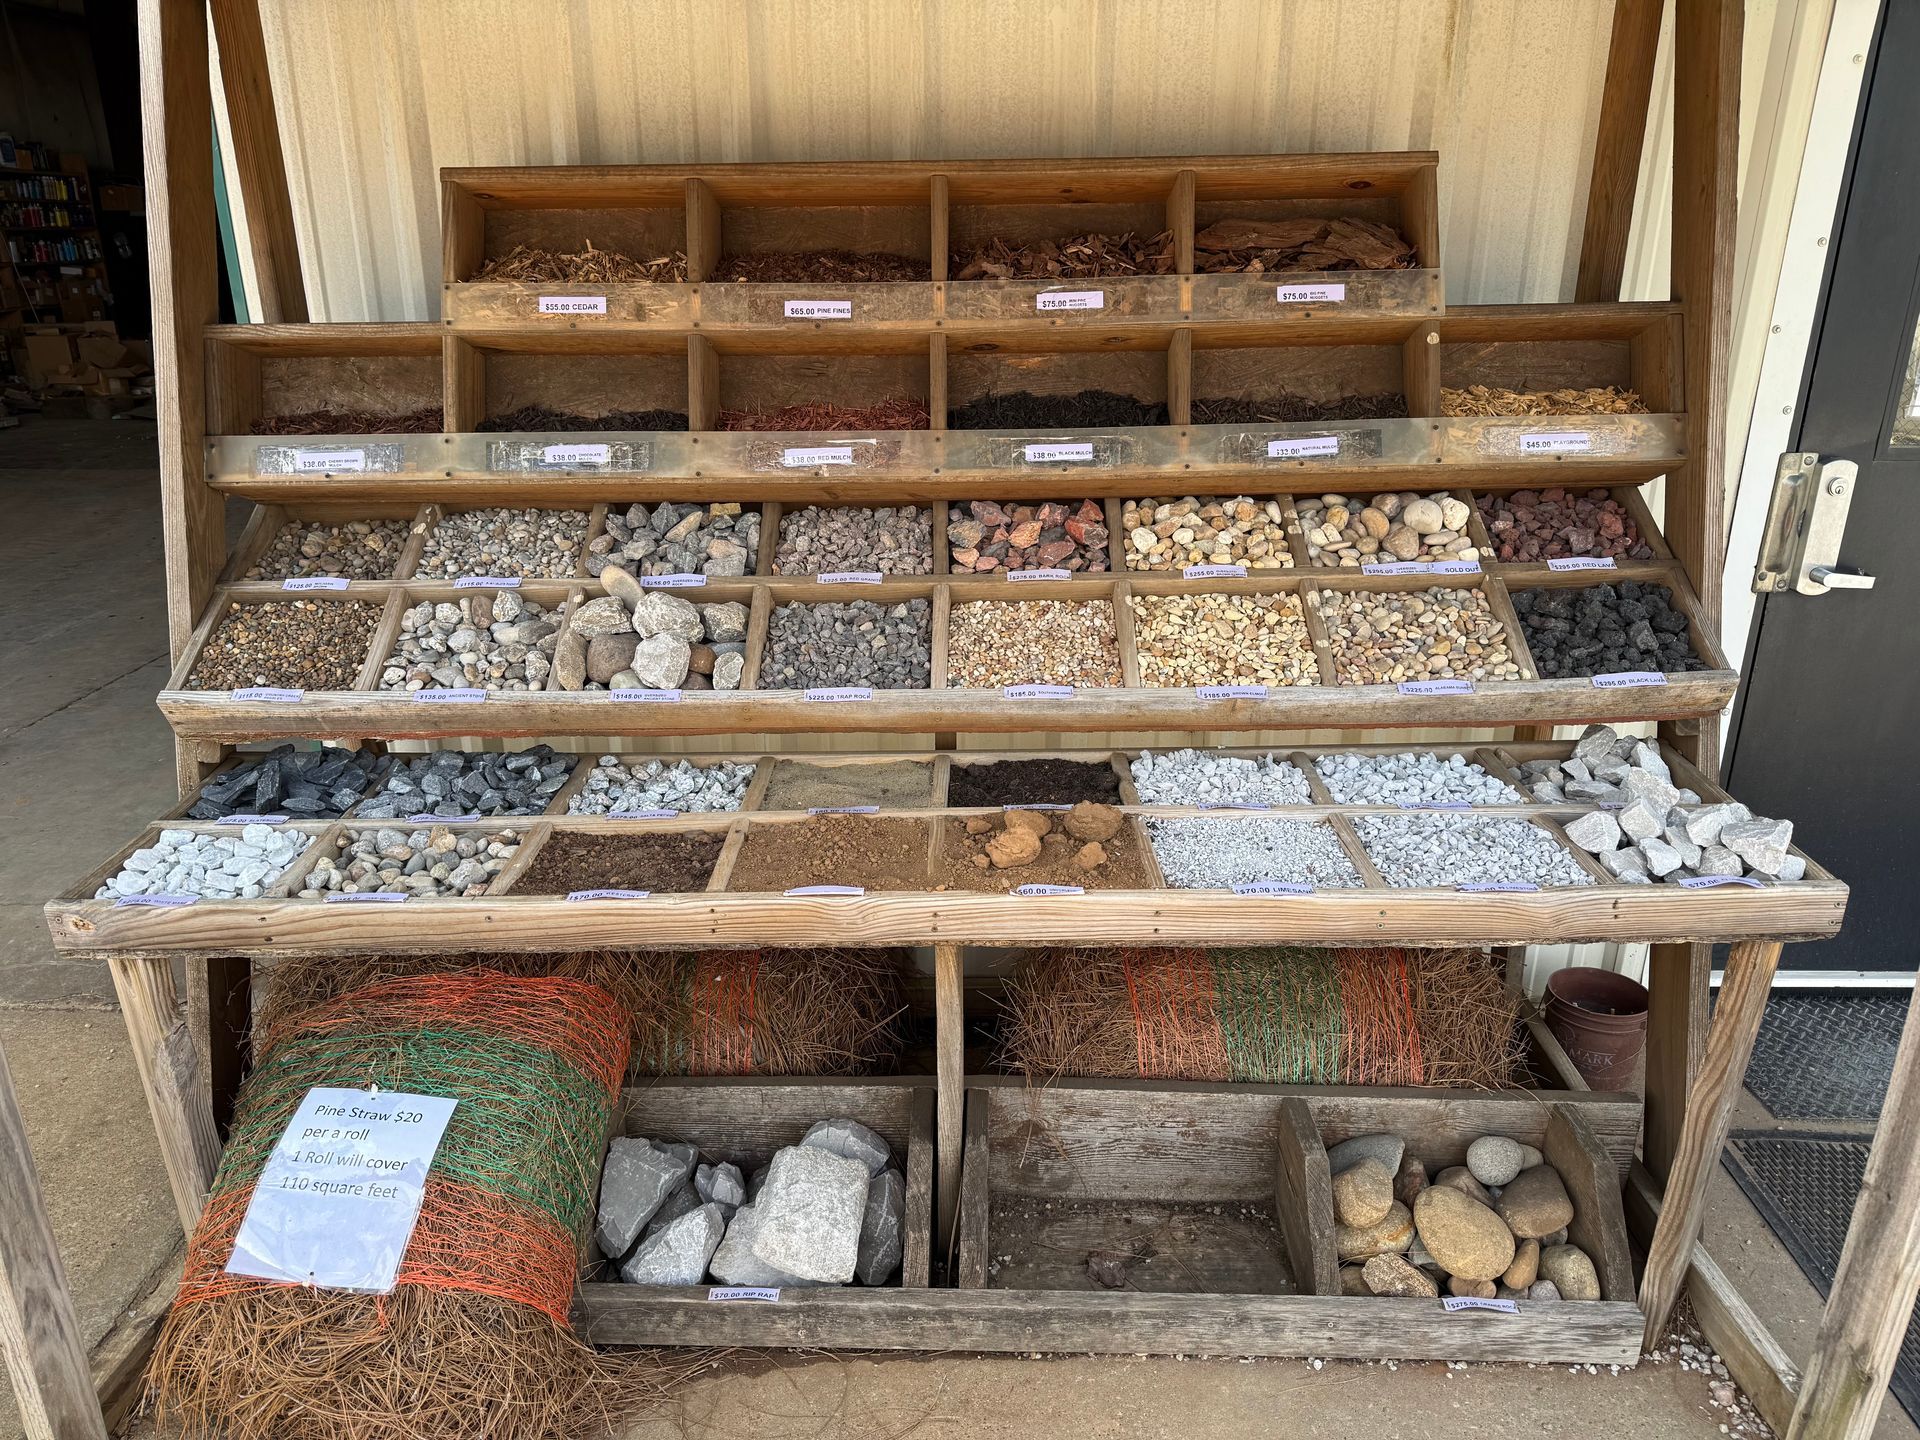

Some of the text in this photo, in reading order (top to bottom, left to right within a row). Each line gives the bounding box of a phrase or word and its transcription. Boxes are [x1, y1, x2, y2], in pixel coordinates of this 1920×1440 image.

[1282, 292, 1308, 300] $75.00
[545, 303, 570, 311] $55.00
[1042, 300, 1067, 308] $75.00
[790, 307, 815, 315] $65.00
[1526, 441, 1551, 449] $45.00
[552, 454, 577, 462] $38.00
[1033, 451, 1057, 459] $38.00
[792, 456, 815, 464] $38.00
[314, 1104, 424, 1125] Pine Straw $20
[301, 1126, 371, 1142] per a roll
[291, 1150, 409, 1172] 1 Roll will cover
[279, 1175, 399, 1200] 110 square feet
[1450, 1301, 1479, 1309] $275.00
